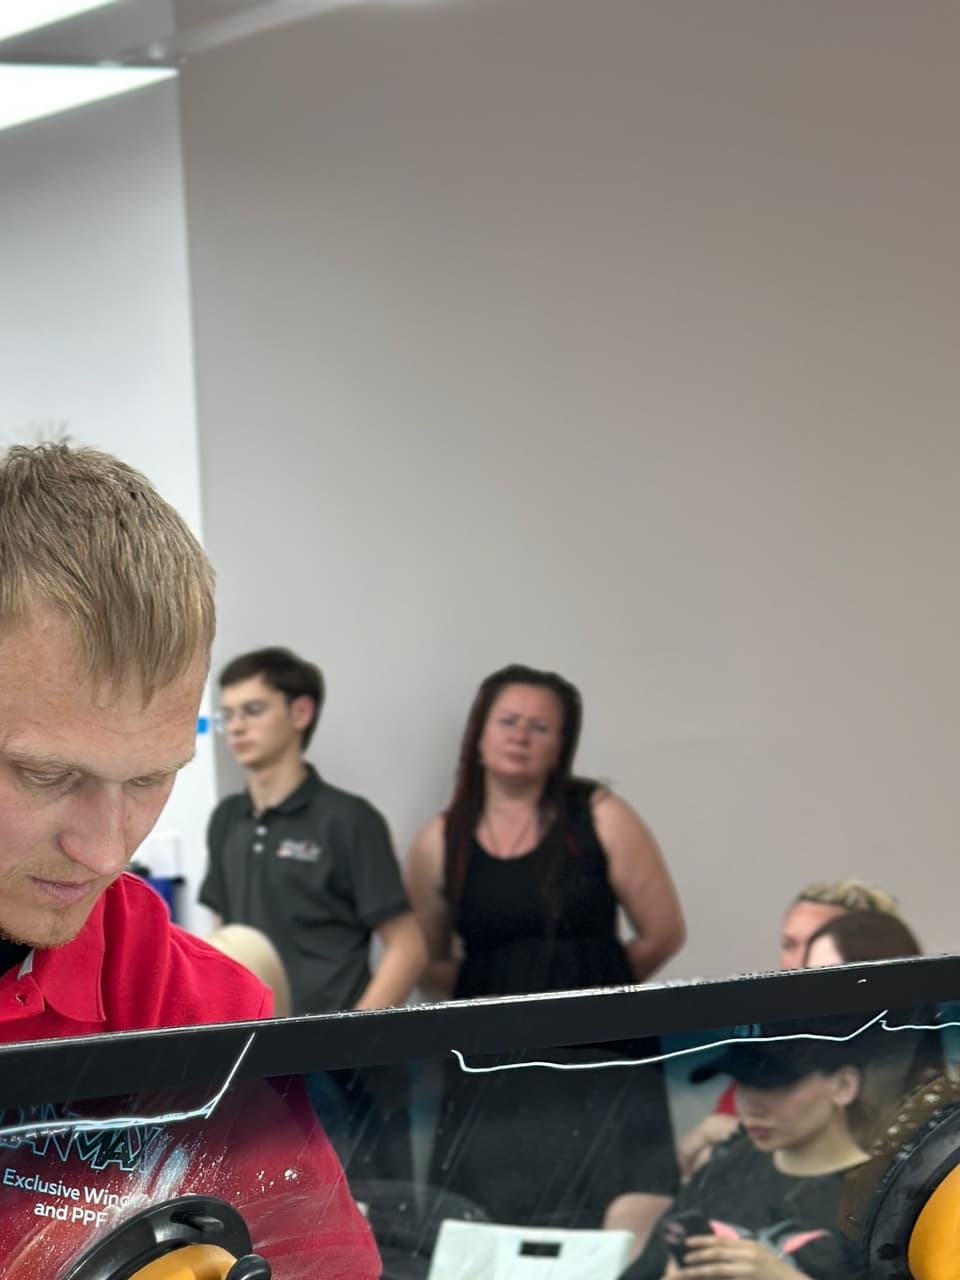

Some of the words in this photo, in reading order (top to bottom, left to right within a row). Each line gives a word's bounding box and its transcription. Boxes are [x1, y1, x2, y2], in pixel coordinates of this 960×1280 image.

[3, 1168, 81, 1201] Exclusive
[34, 1202, 68, 1221] and
[71, 1207, 108, 1228] PPF
